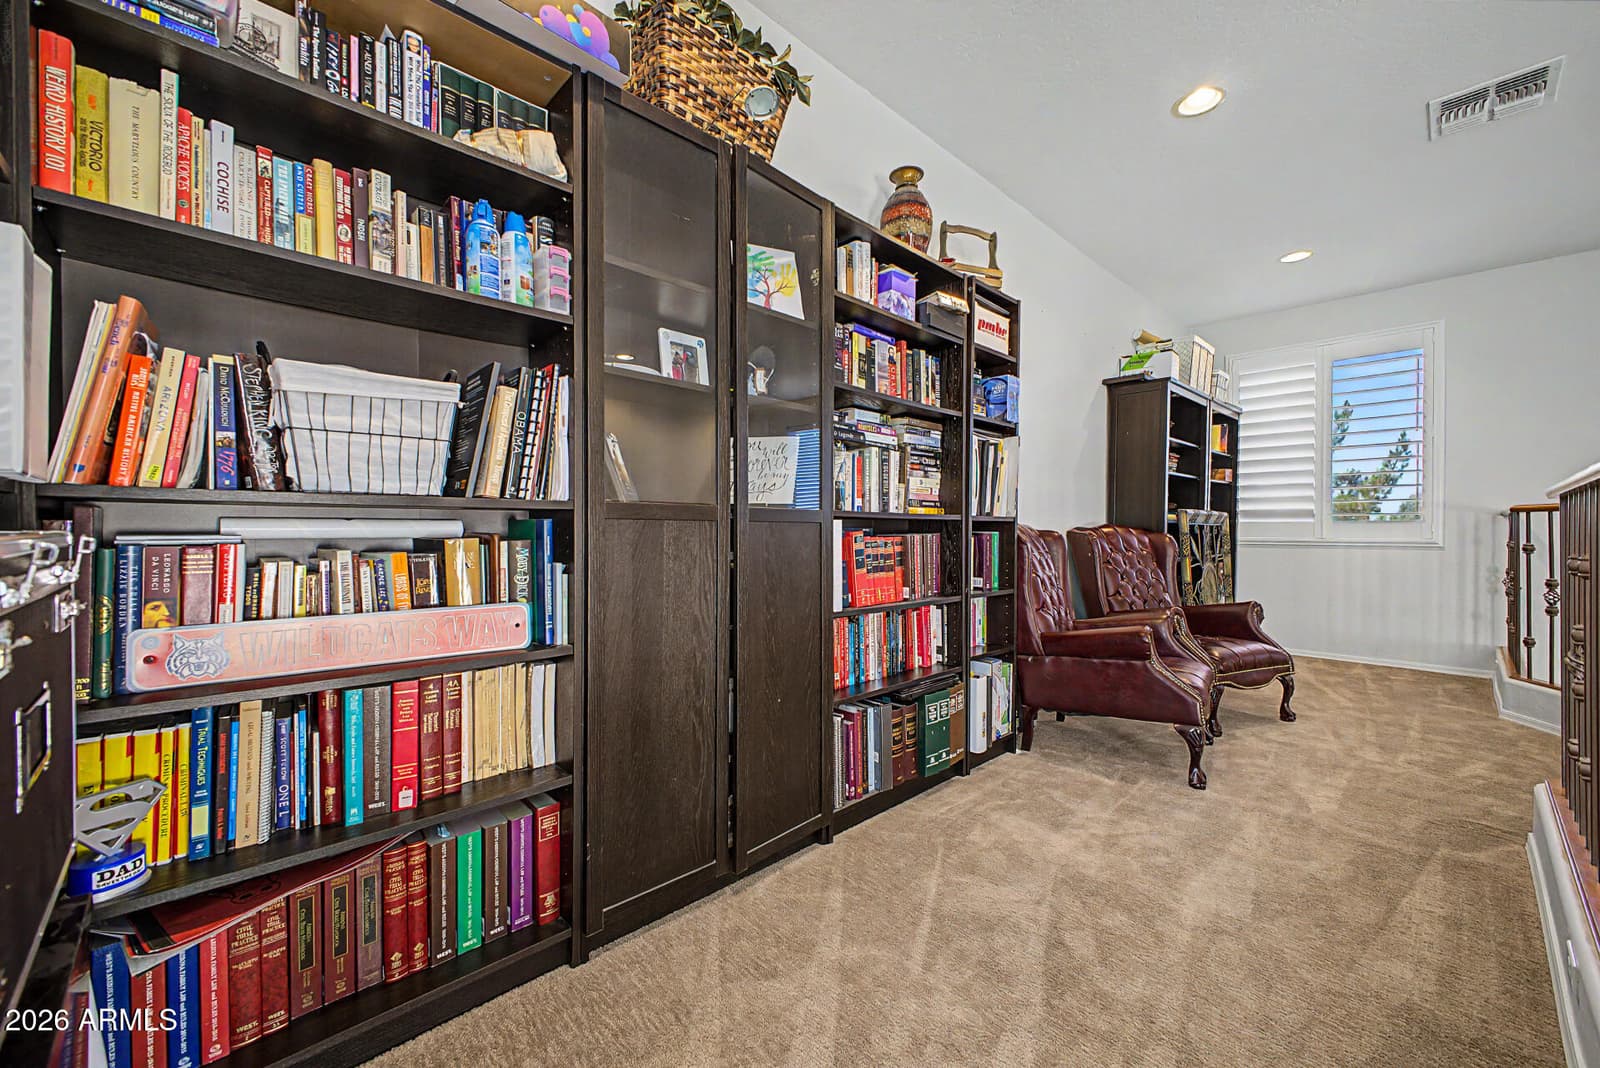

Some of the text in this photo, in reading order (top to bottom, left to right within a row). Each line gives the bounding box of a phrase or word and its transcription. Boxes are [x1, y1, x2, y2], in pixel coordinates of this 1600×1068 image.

[163, 82, 173, 95] THE
[44, 65, 67, 173] WEIRD HISTORY 101
[163, 97, 173, 117] SIOUX
[163, 119, 173, 129] OF
[88, 120, 104, 172] VICTORIO
[131, 106, 140, 200] THE MARVELOUS COUNTRY
[163, 130, 173, 144] THE
[162, 146, 173, 176] ROSEBUD
[177, 122, 190, 192] APACHE VOICES
[296, 166, 304, 181] AND
[217, 161, 230, 214] COCHISE
[263, 179, 272, 216] CAPTURED
[219, 366, 229, 385] DAVID
[243, 362, 264, 405] STEPHEN
[157, 385, 174, 433] ARIZONA
[248, 406, 273, 440] KING
[119, 391, 141, 476] NATIVE AMERICAN HISTORY
[513, 411, 527, 454] OBAMA
[216, 449, 237, 479] 1776
[118, 560, 128, 590] LIZZIE
[151, 556, 159, 591] DA VINCI
[163, 553, 171, 594] LEONARDO
[221, 553, 232, 601] SAPIENS
[377, 563, 386, 598] HARPER LEE
[394, 573, 408, 592] LORDS
[118, 593, 128, 628] BORDEN
[239, 611, 514, 670] WILDCATS WAY
[195, 727, 209, 787] TRIAL TECHNIQUES
[180, 763, 188, 801] CRIMINAL
[279, 784, 289, 807] ONE
[160, 793, 170, 838] PROCEDURE
[96, 857, 144, 884] DAD
[231, 935, 259, 949] PRACTICE
